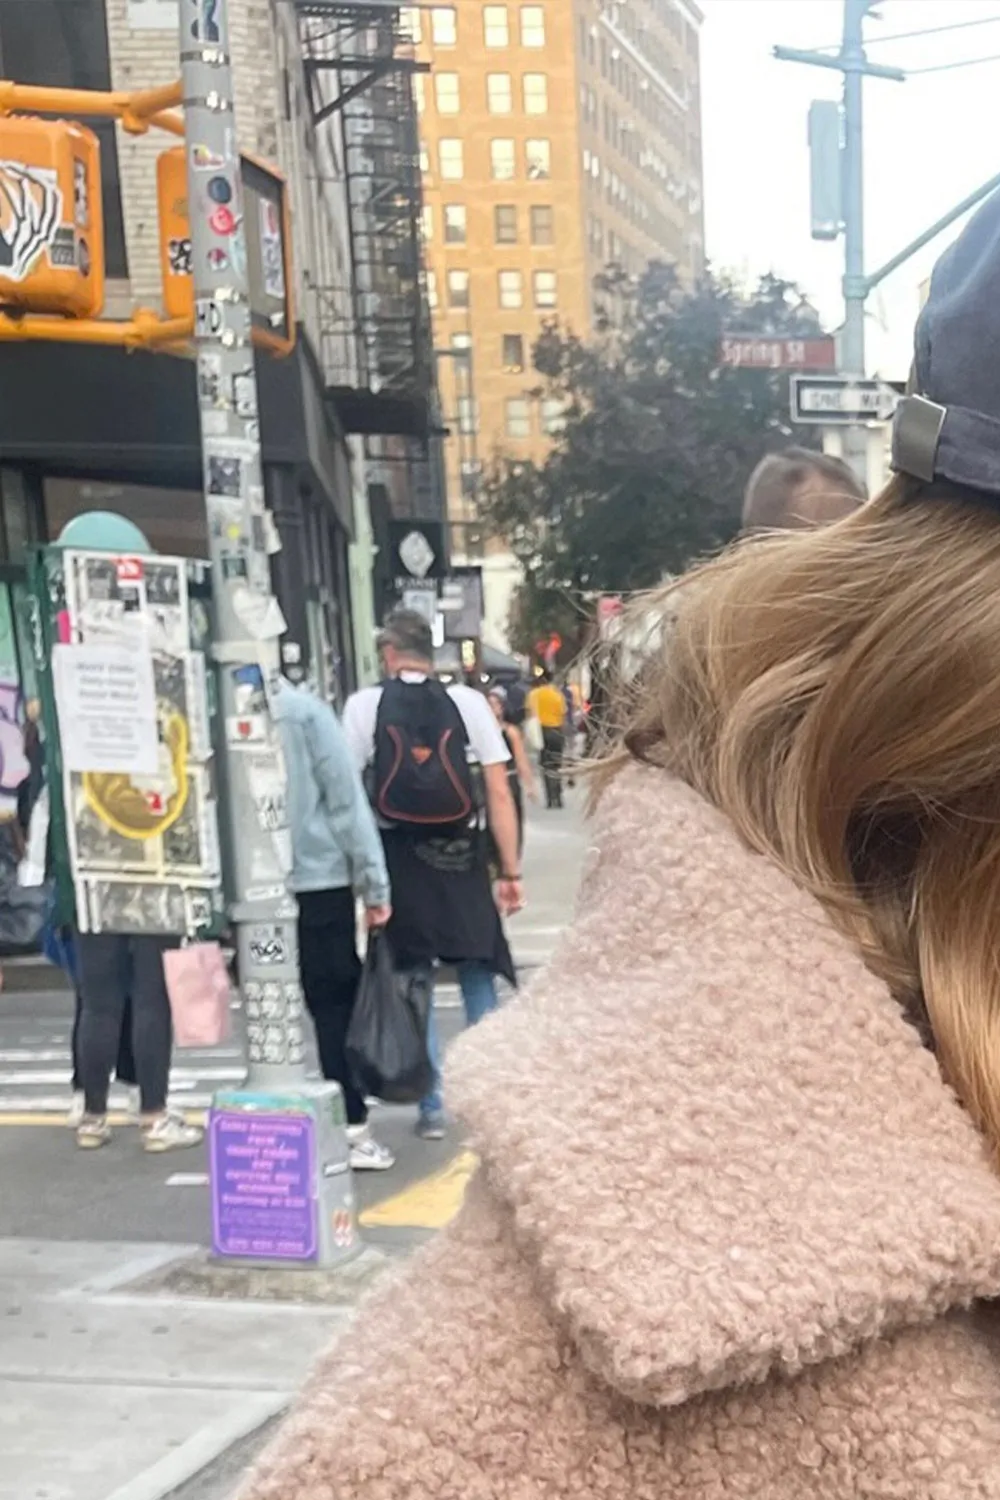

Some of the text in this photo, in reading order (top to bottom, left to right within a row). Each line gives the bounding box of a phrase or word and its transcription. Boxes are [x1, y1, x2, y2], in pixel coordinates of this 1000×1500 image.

[721, 340, 805, 368] Spring St
[810, 391, 842, 409] ONE
